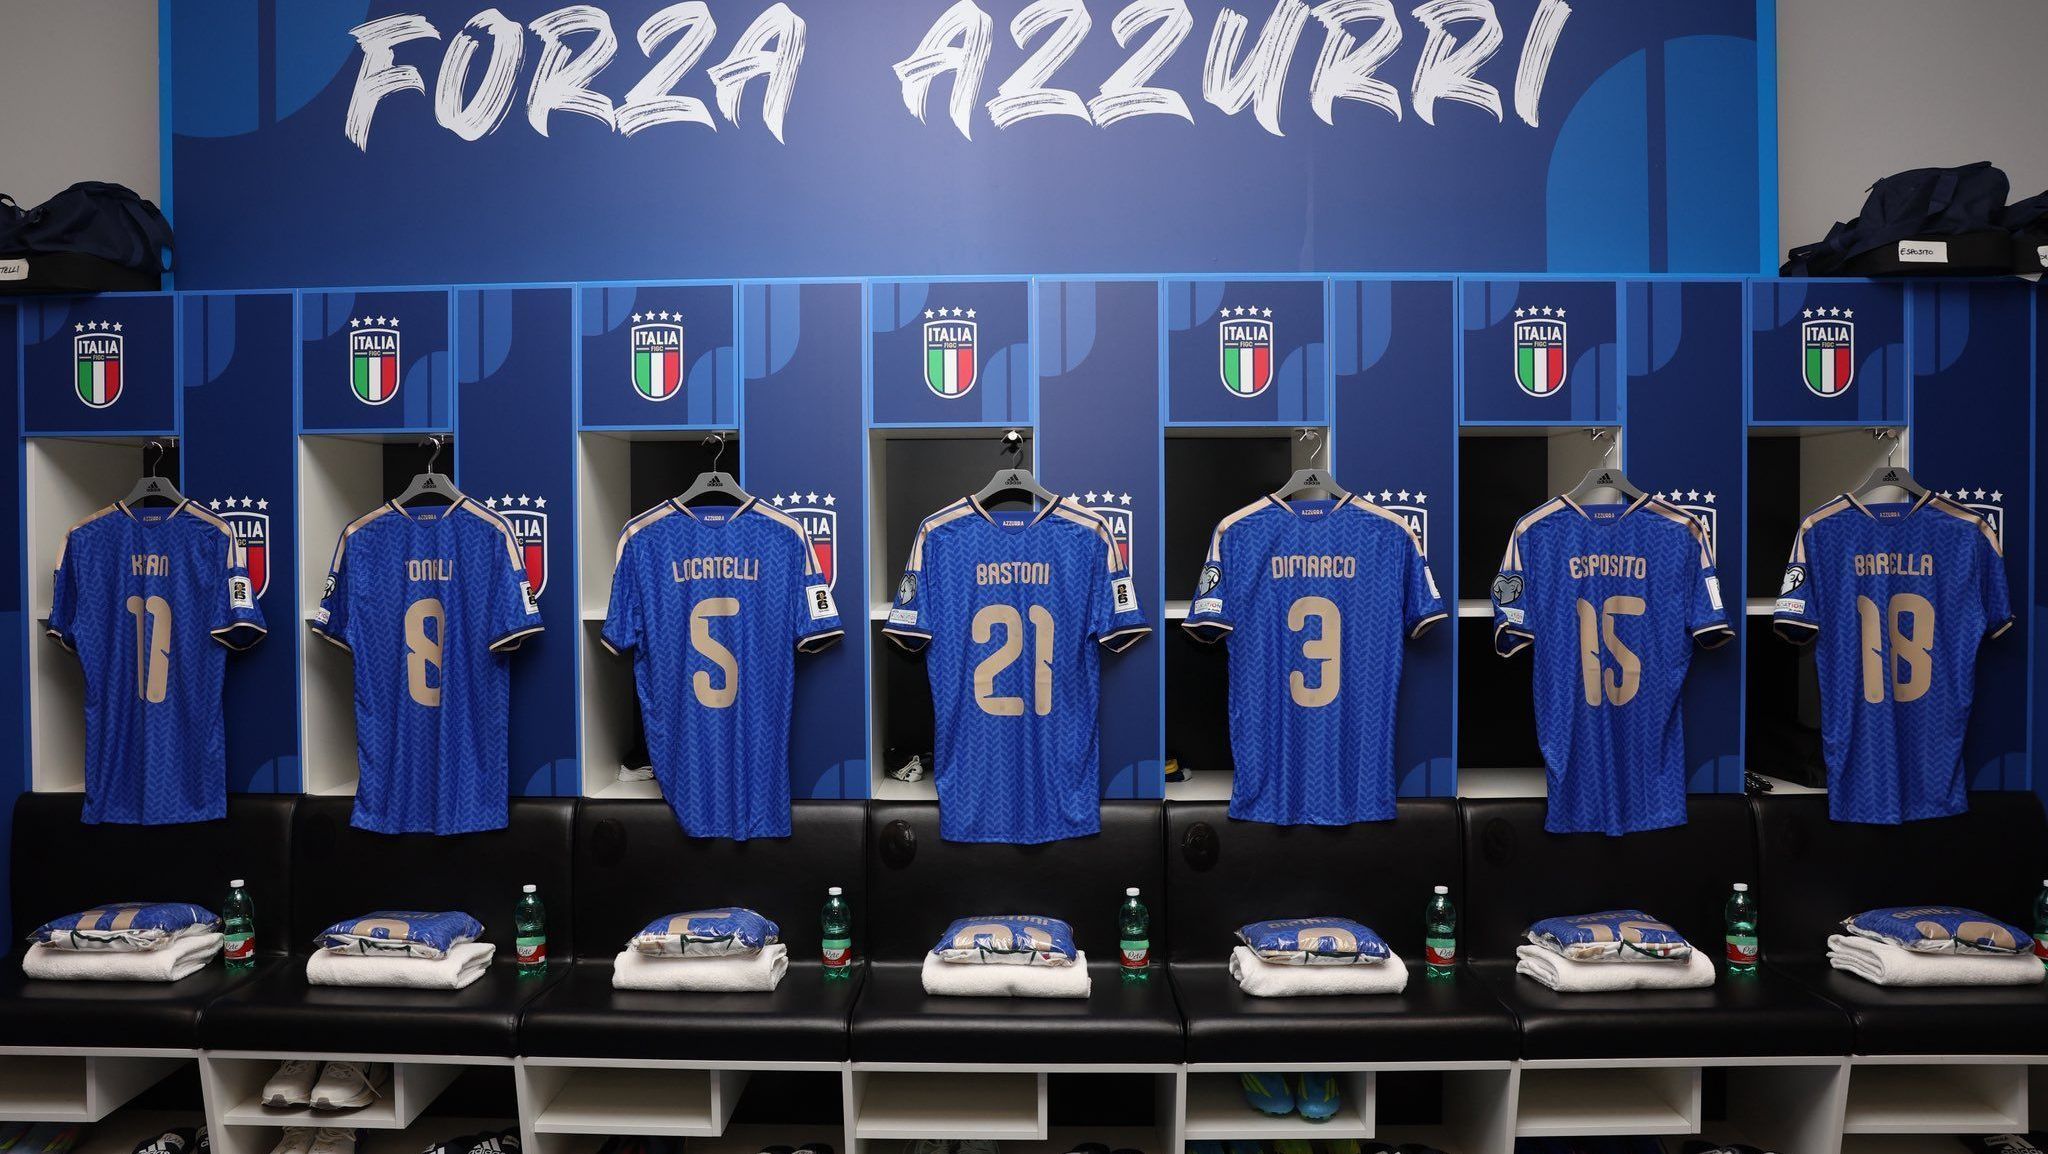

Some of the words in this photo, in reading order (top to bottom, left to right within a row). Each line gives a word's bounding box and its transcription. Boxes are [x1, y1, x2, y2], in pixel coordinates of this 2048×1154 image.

[345, 0, 806, 153] FORZA
[892, 0, 1572, 141] AZZURRI
[1900, 247, 1934, 256] ESPOSITO
[354, 335, 395, 349] ITALIA
[636, 331, 679, 345] ITALIA
[928, 327, 972, 341] ITALIA
[1224, 326, 1268, 340] ITALIA
[1519, 326, 1562, 340] ITALIA
[1806, 327, 1850, 341] ITALIA
[78, 340, 119, 354] ITALIA
[230, 521, 264, 537] ALIA
[131, 554, 169, 576] KAN
[405, 559, 454, 582] ONLI
[672, 556, 760, 583] LOCATELLI
[976, 561, 1050, 586] BASTONI
[1271, 555, 1356, 579] DIMARCO
[1569, 554, 1647, 580] ESPOSITO
[1854, 552, 1934, 577] BARELLA
[404, 598, 445, 707] 8
[690, 597, 740, 708] 5
[972, 604, 1055, 716] 21
[1287, 595, 1341, 708] 3
[1576, 595, 1646, 707] 15
[1856, 593, 1935, 704] 18
